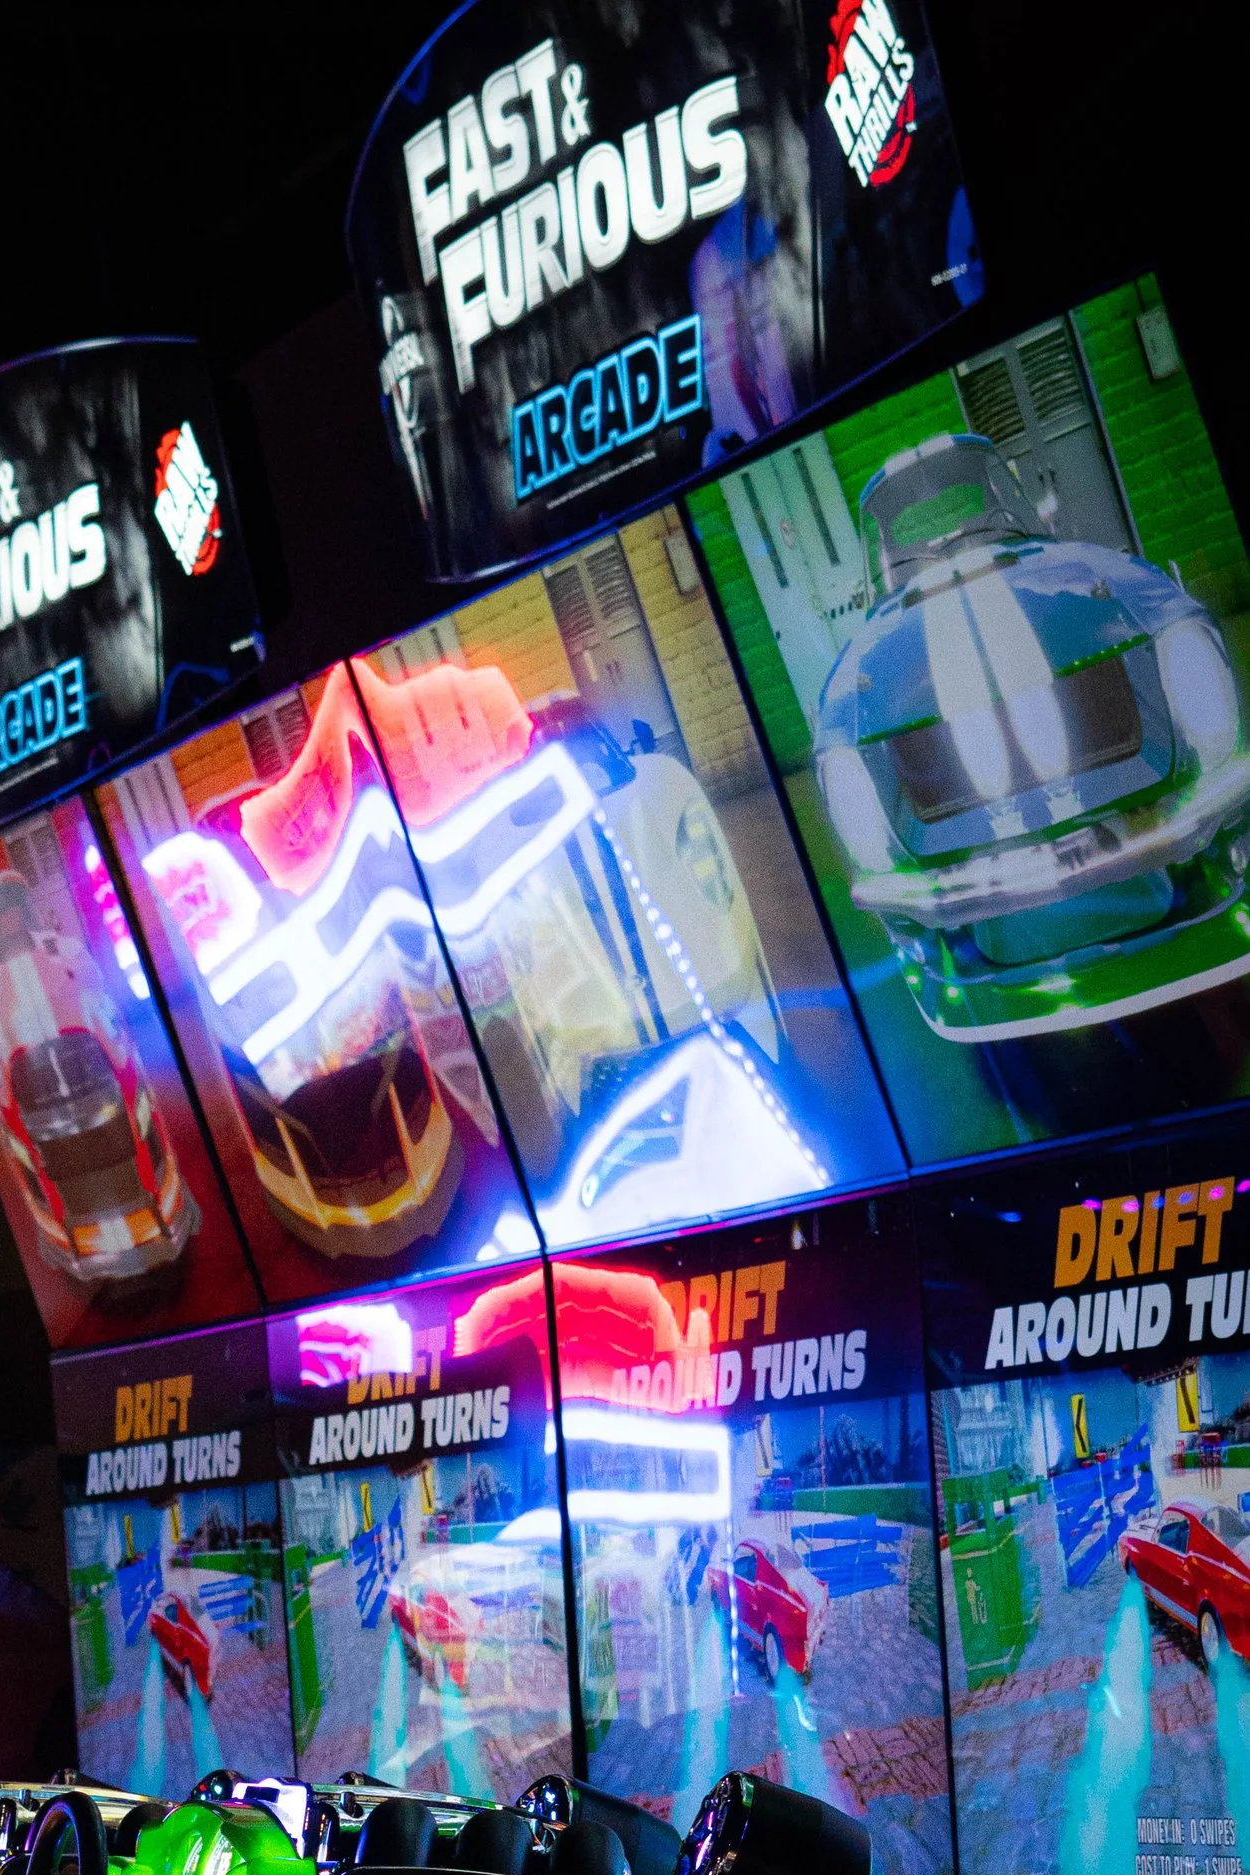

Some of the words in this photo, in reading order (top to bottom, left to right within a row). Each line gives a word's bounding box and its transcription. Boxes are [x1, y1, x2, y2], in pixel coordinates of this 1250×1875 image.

[824, 0, 897, 156] RAW
[848, 36, 914, 188] THRILLS
[403, 38, 559, 287] FAST
[561, 62, 591, 146] &
[439, 75, 748, 394] FURIOUS
[512, 313, 704, 499] ARCADE
[1054, 1176, 1236, 1289] DRIFT
[654, 1261, 787, 1353] DRIFT
[984, 1283, 1172, 1370] AROUND
[1184, 1269, 1250, 1343] TU
[115, 1375, 193, 1443] DRIFT
[752, 1329, 868, 1402] TURNS
[86, 1440, 169, 1495] AROUND
[171, 1430, 242, 1484] TURNS
[309, 1402, 414, 1466] AROUND
[422, 1385, 511, 1448] TURNS
[1137, 1817, 1169, 1845] MONEY
[1172, 1818, 1185, 1844] IN:
[1199, 1818, 1236, 1846] SWIPES
